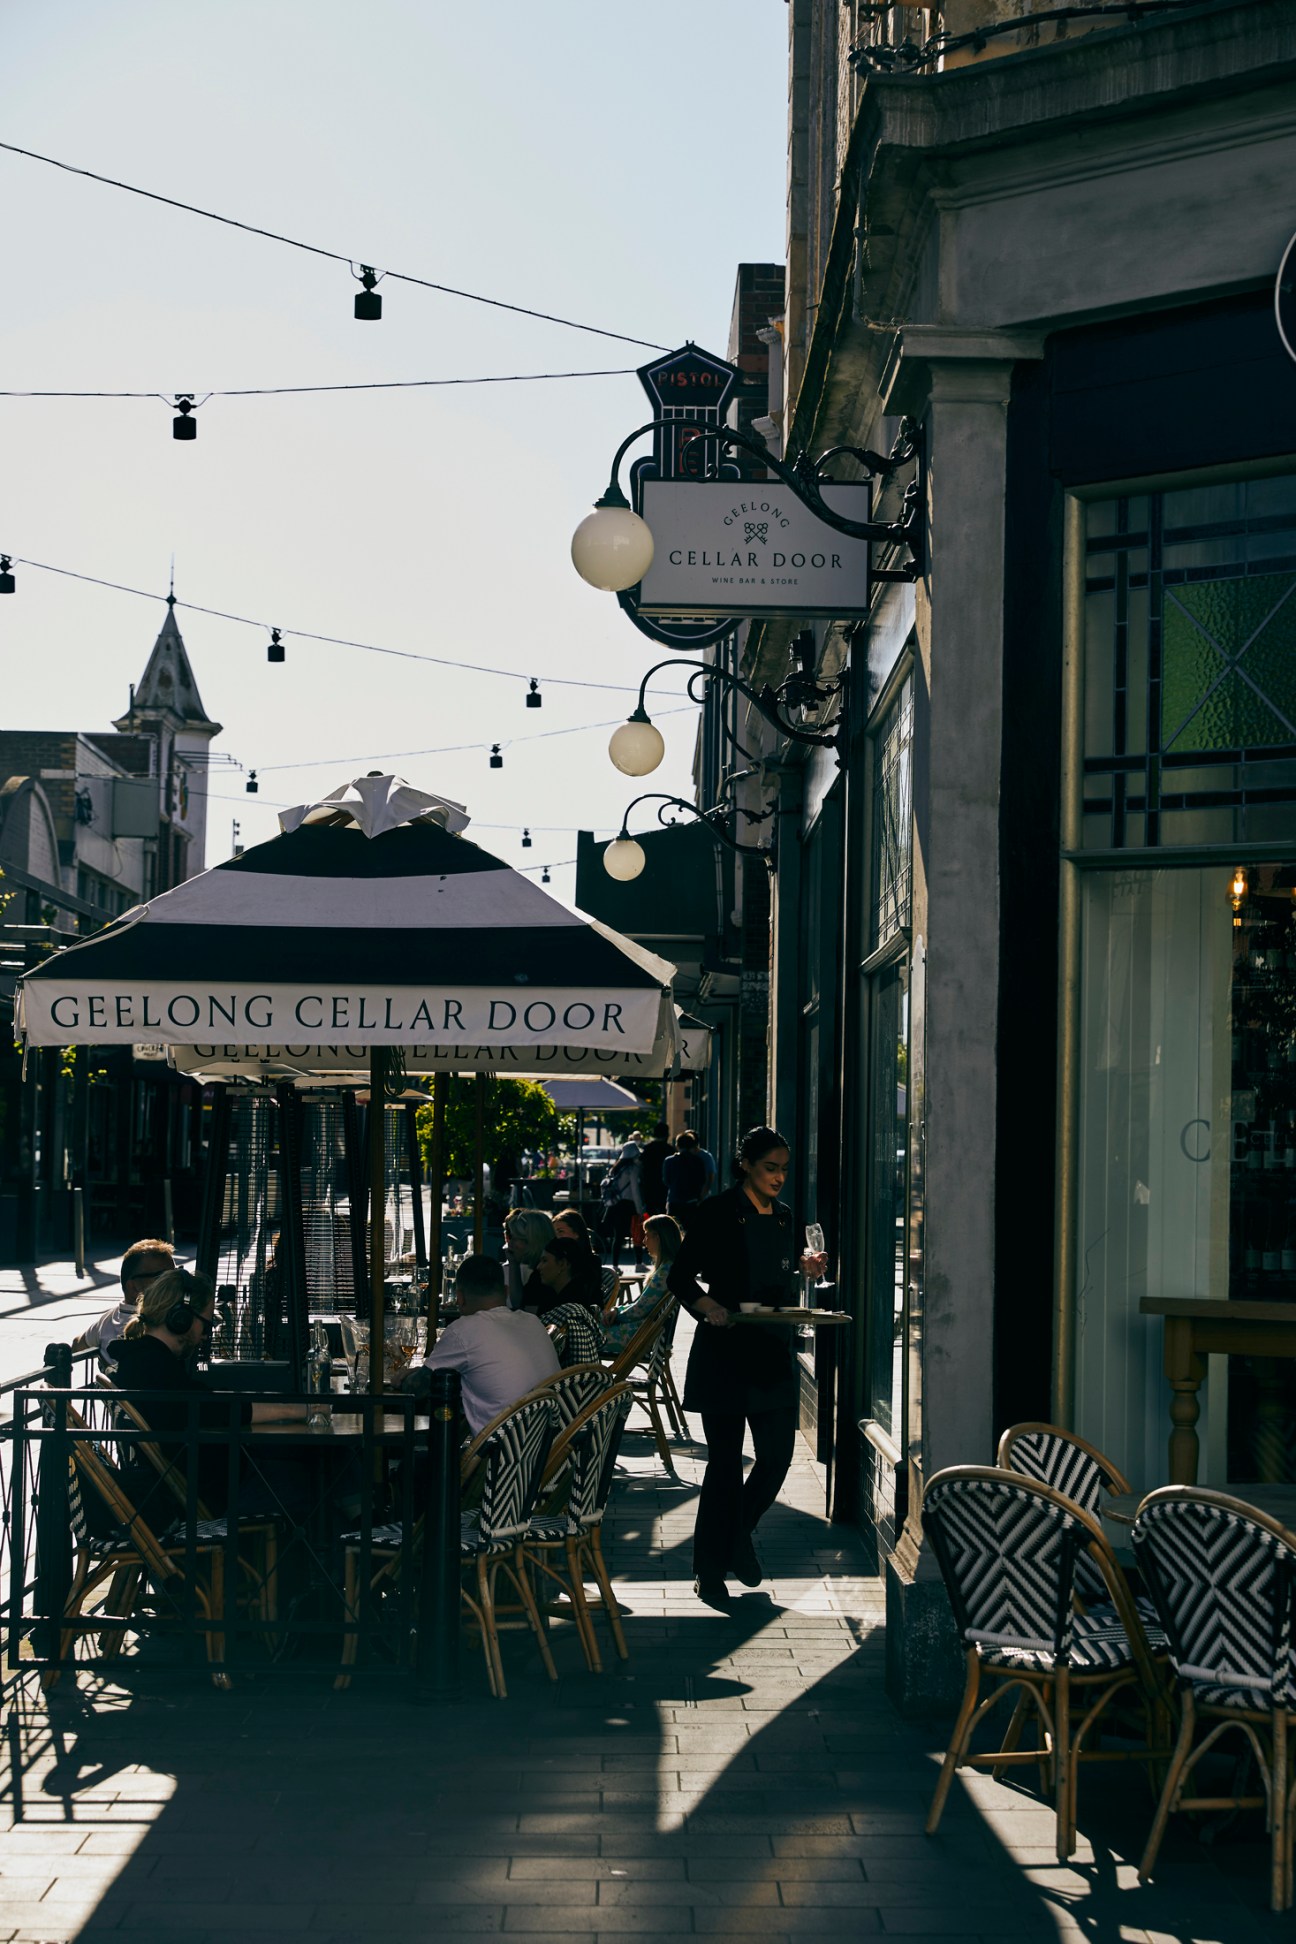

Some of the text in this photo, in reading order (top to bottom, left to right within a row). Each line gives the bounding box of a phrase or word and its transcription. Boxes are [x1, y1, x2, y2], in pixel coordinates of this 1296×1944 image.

[658, 371, 724, 387] PISTOL
[723, 501, 790, 528] GEELONG
[669, 550, 842, 568] CELLAR DOOR
[739, 577, 756, 585] BAR
[760, 577, 766, 585] &
[50, 994, 626, 1034] GEELONG CELLAR DOOR
[402, 1045, 519, 1061] ELLAR
